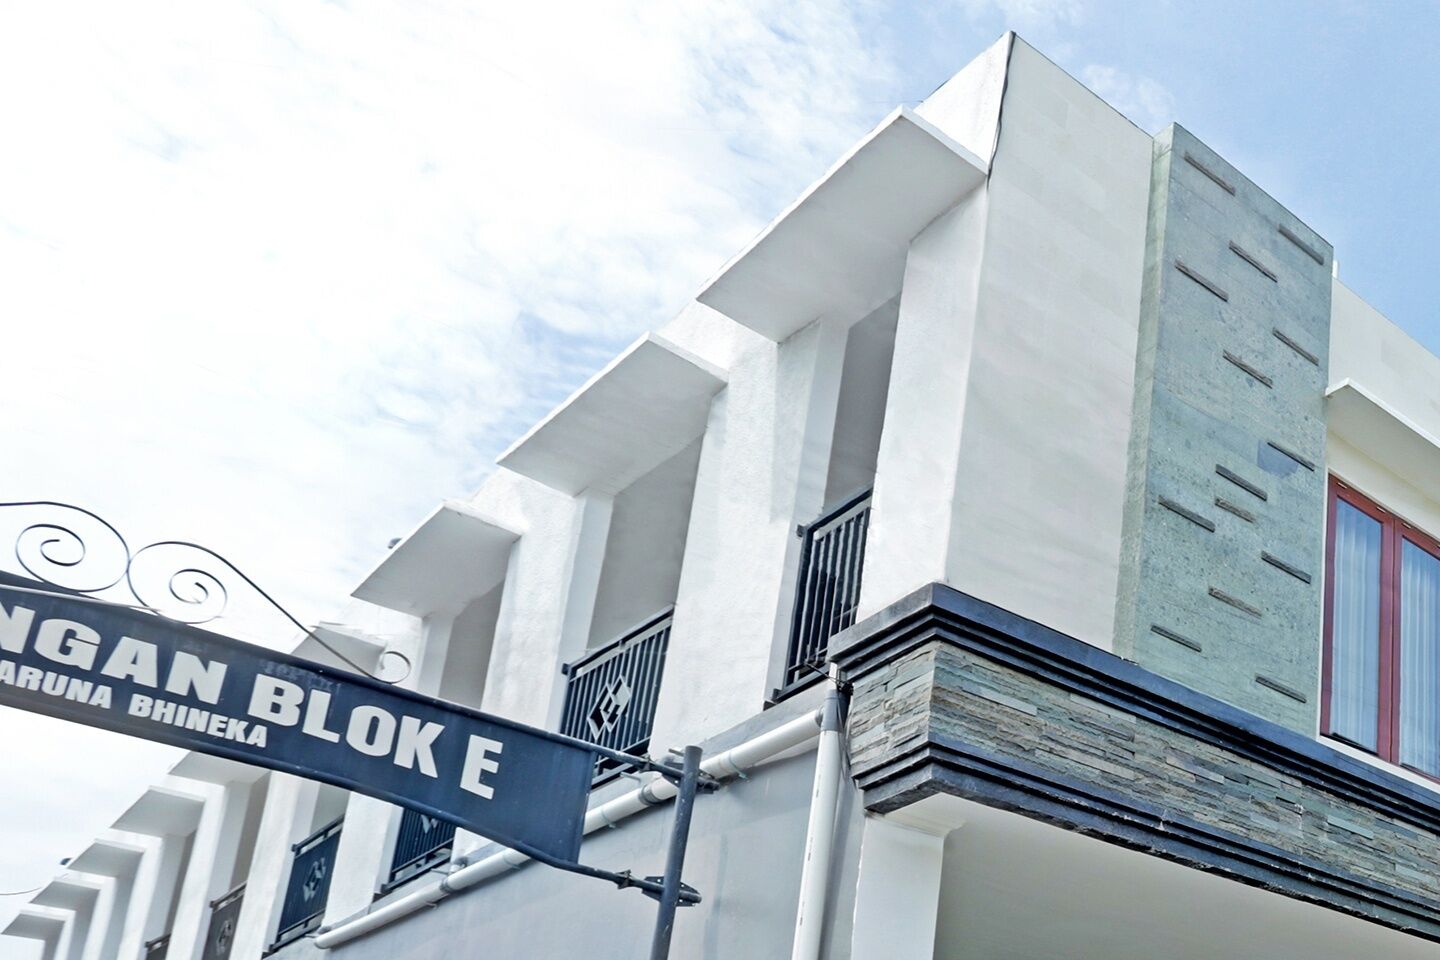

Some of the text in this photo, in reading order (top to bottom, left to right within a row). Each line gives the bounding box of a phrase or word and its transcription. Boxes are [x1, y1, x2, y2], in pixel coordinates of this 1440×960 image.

[128, 694, 267, 748] BHINEKA
[248, 674, 445, 778] BLOK
[460, 734, 503, 800] E
